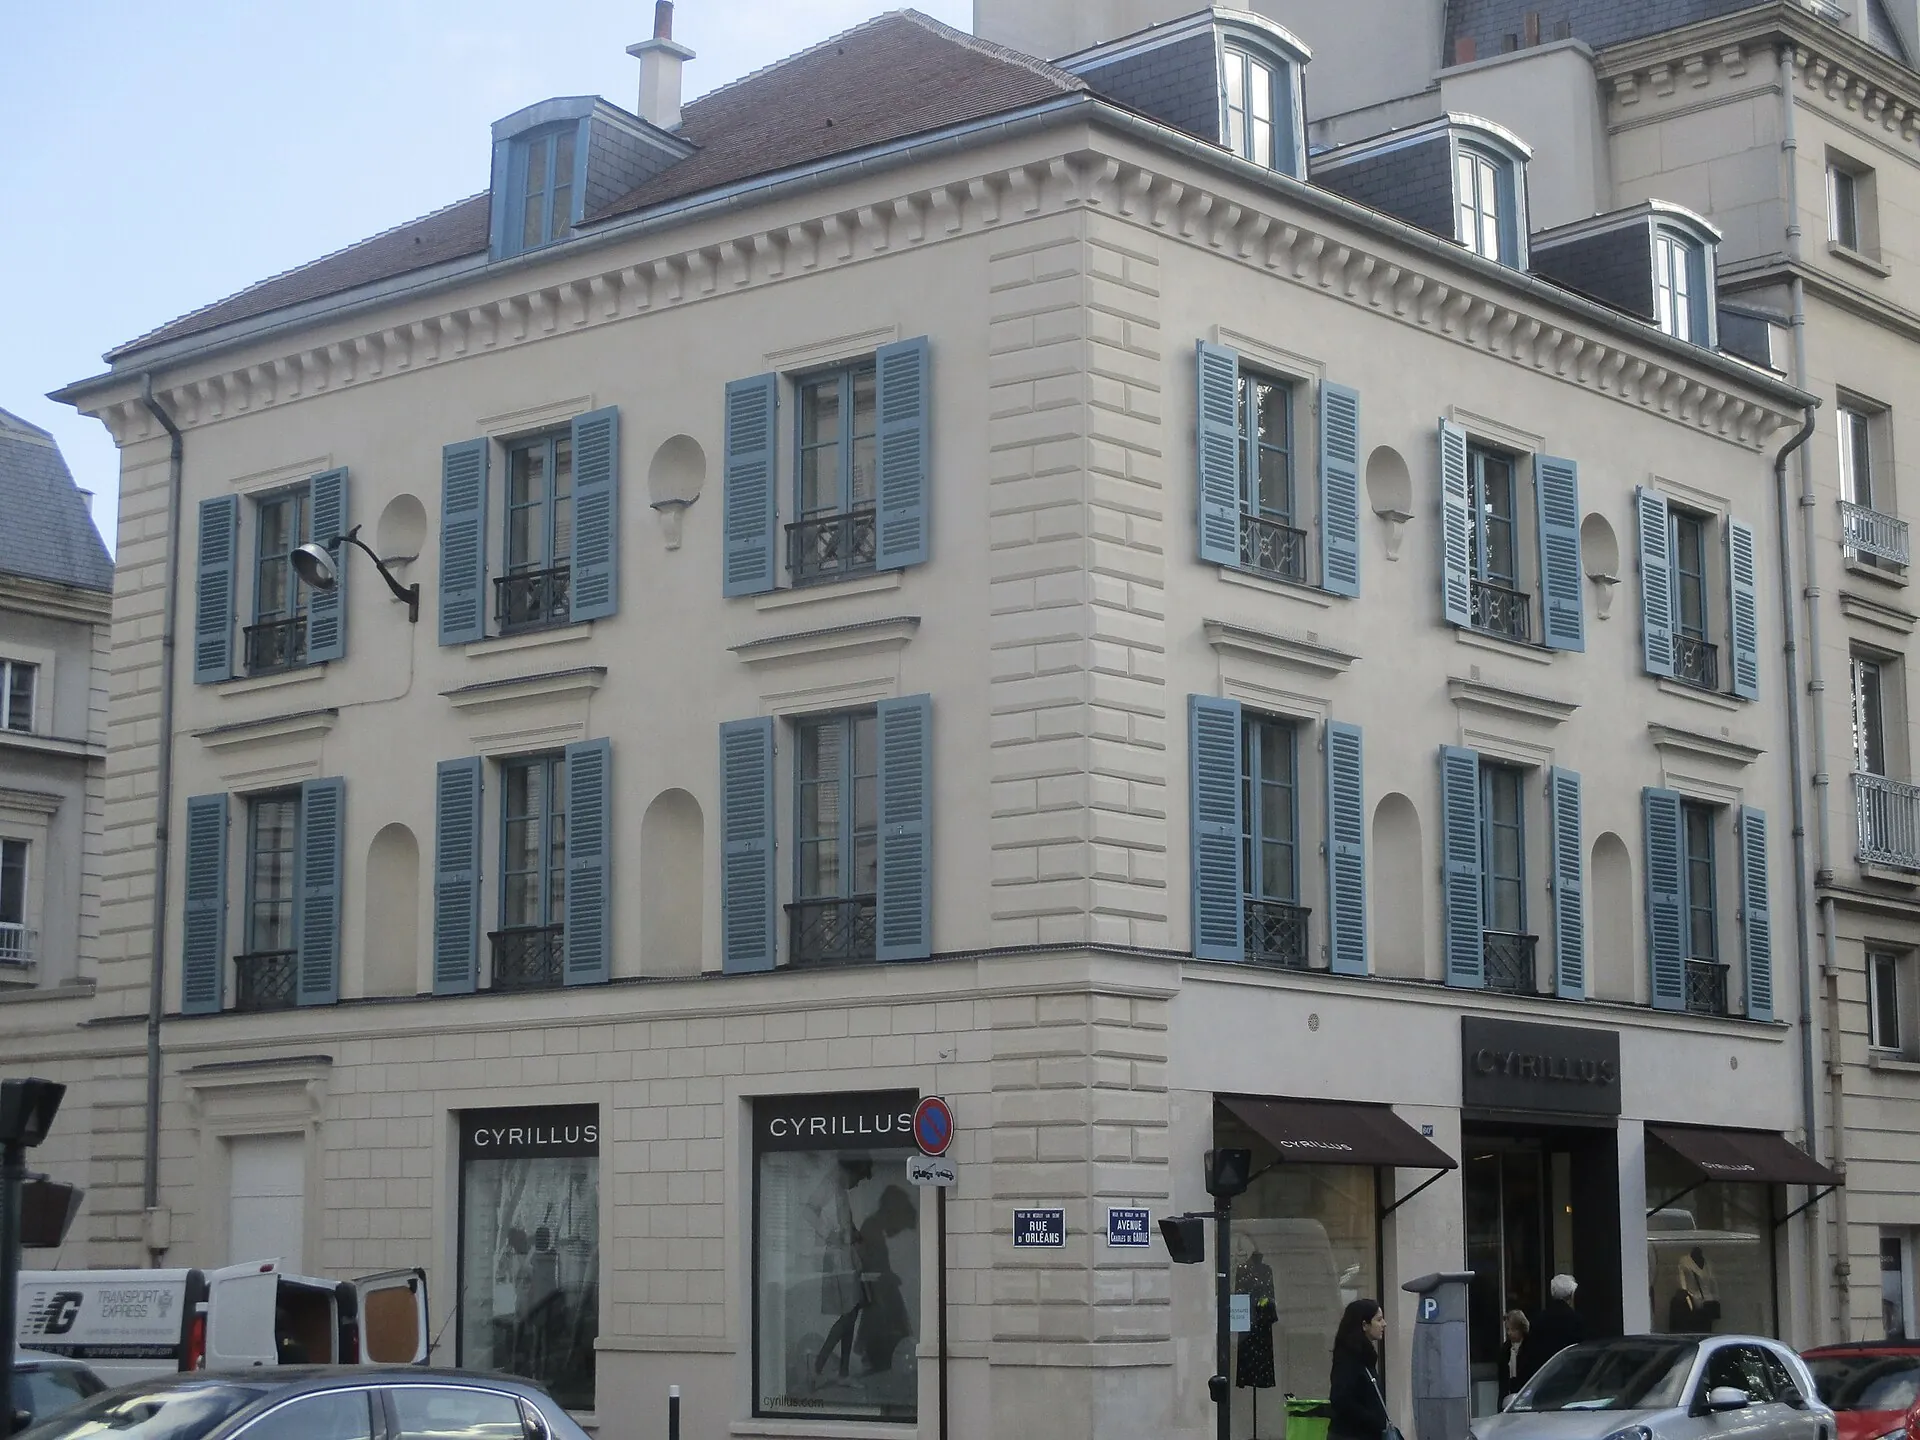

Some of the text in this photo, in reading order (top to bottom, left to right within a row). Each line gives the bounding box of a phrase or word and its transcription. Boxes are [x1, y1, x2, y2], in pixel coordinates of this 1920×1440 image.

[1476, 1048, 1615, 1082] CYRILLUS
[769, 1113, 912, 1137] CYRILLUS
[474, 1125, 598, 1146] CYRILLUS
[1280, 1140, 1353, 1151] CYRILLUS
[1029, 1221, 1047, 1231] RUE
[1117, 1220, 1142, 1230] AVENUE
[98, 1290, 160, 1303] TRANSPORT
[102, 1304, 148, 1318] EXPRESS
[1424, 1298, 1437, 1319] P
[763, 1394, 824, 1408] cyrillus.com
